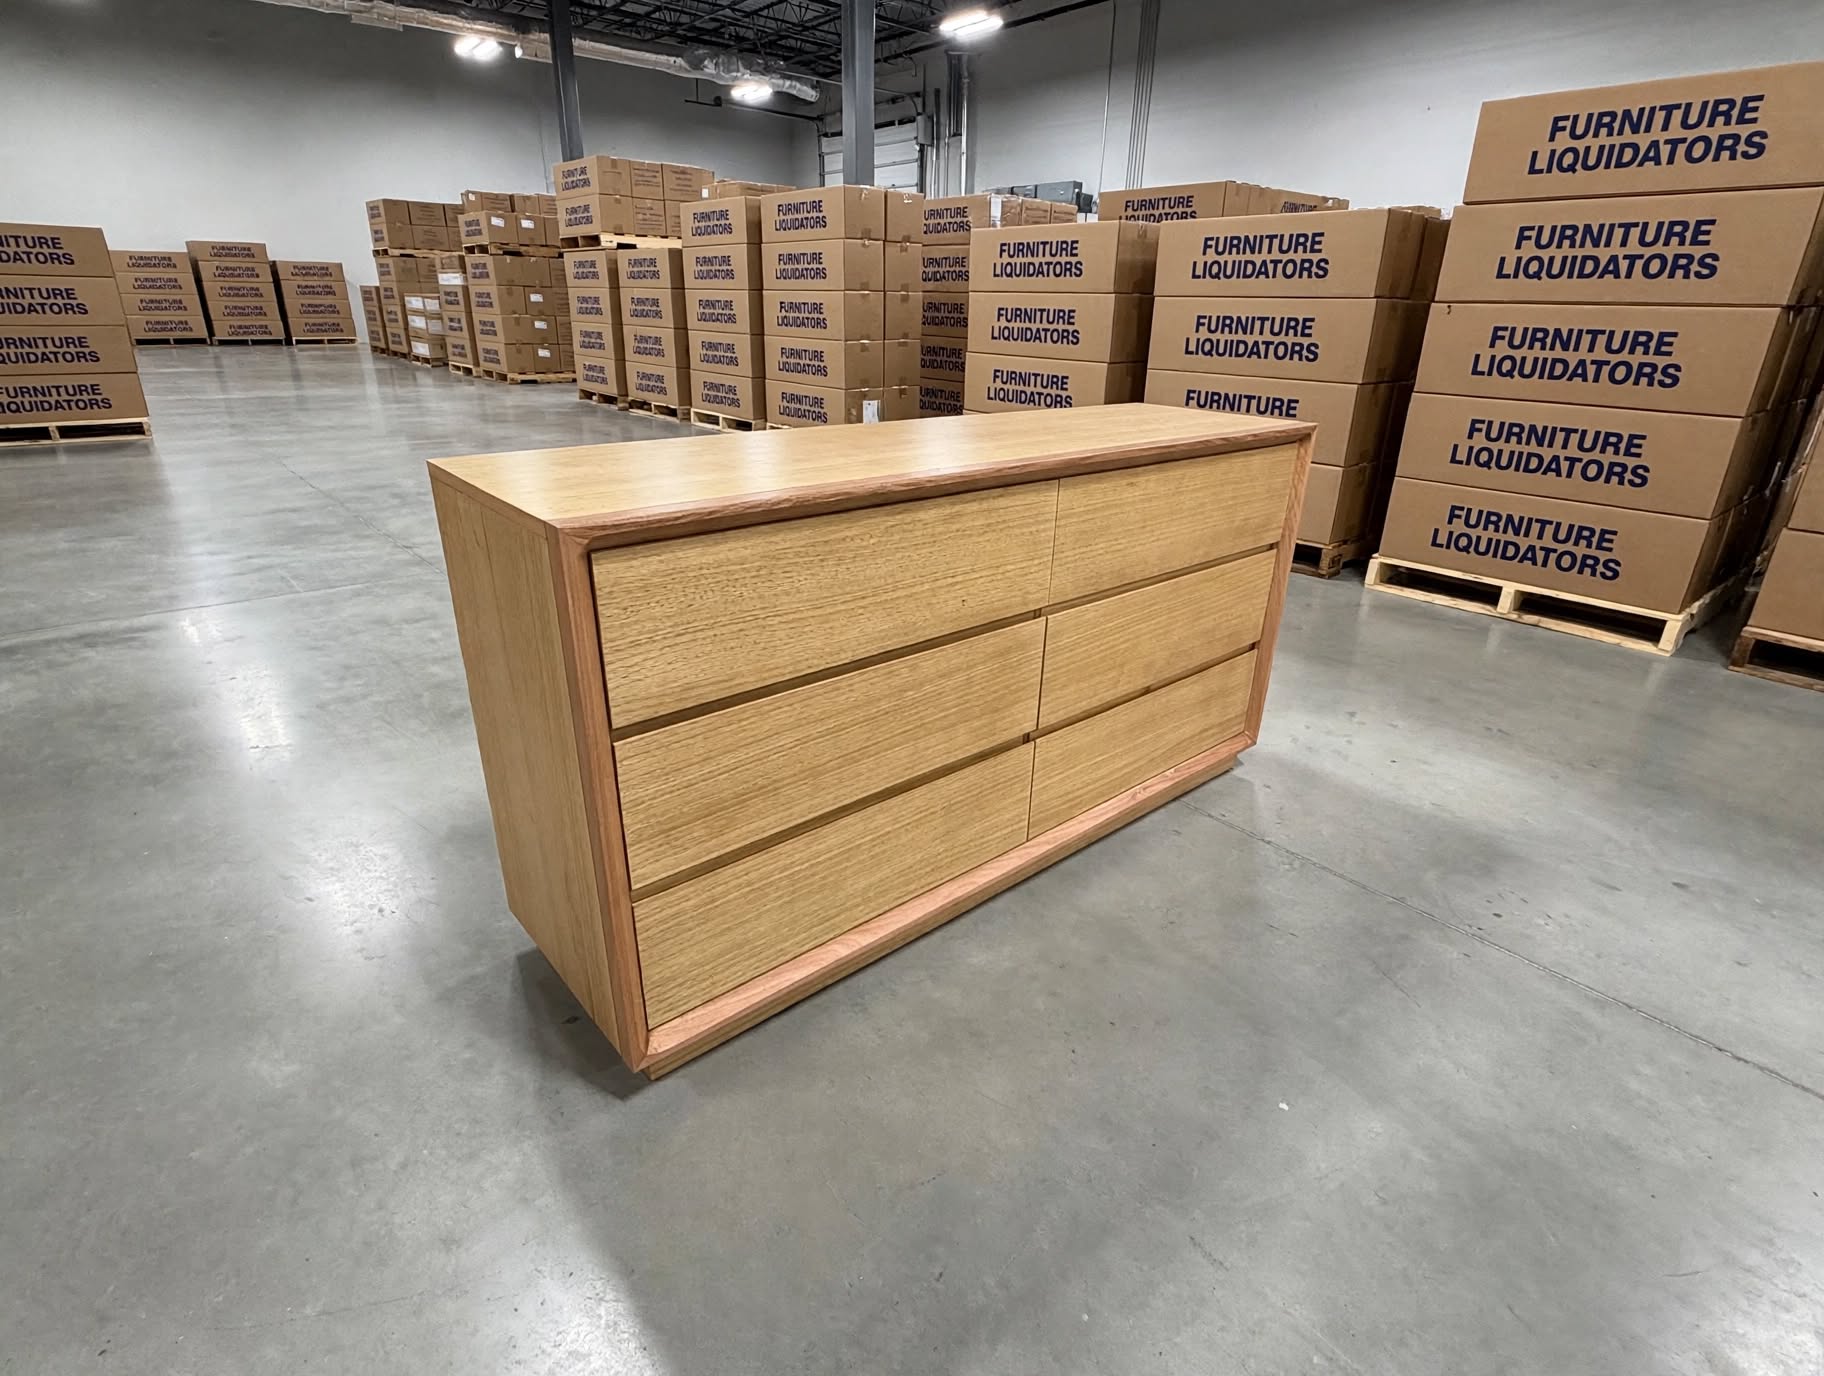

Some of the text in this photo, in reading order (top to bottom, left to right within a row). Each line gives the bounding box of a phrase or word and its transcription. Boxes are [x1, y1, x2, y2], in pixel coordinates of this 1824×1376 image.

[1549, 96, 1763, 142] FURNITURE
[1528, 130, 1767, 175] LIQUIDATORS
[777, 200, 823, 216] FURNITURE
[1124, 195, 1194, 213] FURNITURE
[693, 210, 730, 223] FURNITURE
[775, 216, 827, 232] LIQUIDATORS
[692, 223, 733, 237] LIQUIDATORS
[1516, 219, 1716, 250] FURNITURE
[999, 240, 1079, 258] FURNITURE
[1202, 232, 1325, 256] FURNITURE
[695, 255, 732, 267] FURNITURE
[778, 252, 823, 265] FURNITURE
[1496, 253, 1719, 281] LIQUIDATORS
[694, 269, 735, 280] LIQUIDATORS
[776, 267, 827, 280] LIQUIDATORS
[993, 261, 1083, 278] LIQUIDATORS
[1192, 258, 1330, 280] LIQUIDATORS
[699, 299, 734, 311] FURNITURE
[780, 301, 824, 314] FURNITURE
[697, 312, 736, 324] LIQUIDATORS
[777, 316, 827, 329] LIQUIDATORS
[997, 307, 1076, 325] FURNITURE
[1195, 315, 1315, 337] FURNITURE
[991, 326, 1080, 345] LIQUIDATORS
[1490, 326, 1677, 356] FURNITURE
[701, 341, 735, 354] FURNITURE
[781, 347, 824, 362] FURNITURE
[1184, 337, 1320, 362] LIQUIDATORS
[700, 353, 739, 367] LIQUIDATORS
[778, 361, 828, 377] LIQUIDATORS
[993, 369, 1069, 391] FURNITURE
[1468, 354, 1680, 388] LIQUIDATORS
[703, 381, 737, 396] FURNITURE
[987, 386, 1072, 408] LIQUIDATORS
[702, 392, 740, 408] LIQUIDATORS
[782, 392, 824, 409] FURNITURE
[1185, 389, 1300, 418] FURNITURE
[779, 405, 827, 424] LIQUIDATORS
[1468, 419, 1647, 458] FURNITURE
[1451, 445, 1649, 488] LIQUIDATORS
[1447, 505, 1616, 551] FURNITURE
[1432, 529, 1620, 580] LIQUIDATORS
